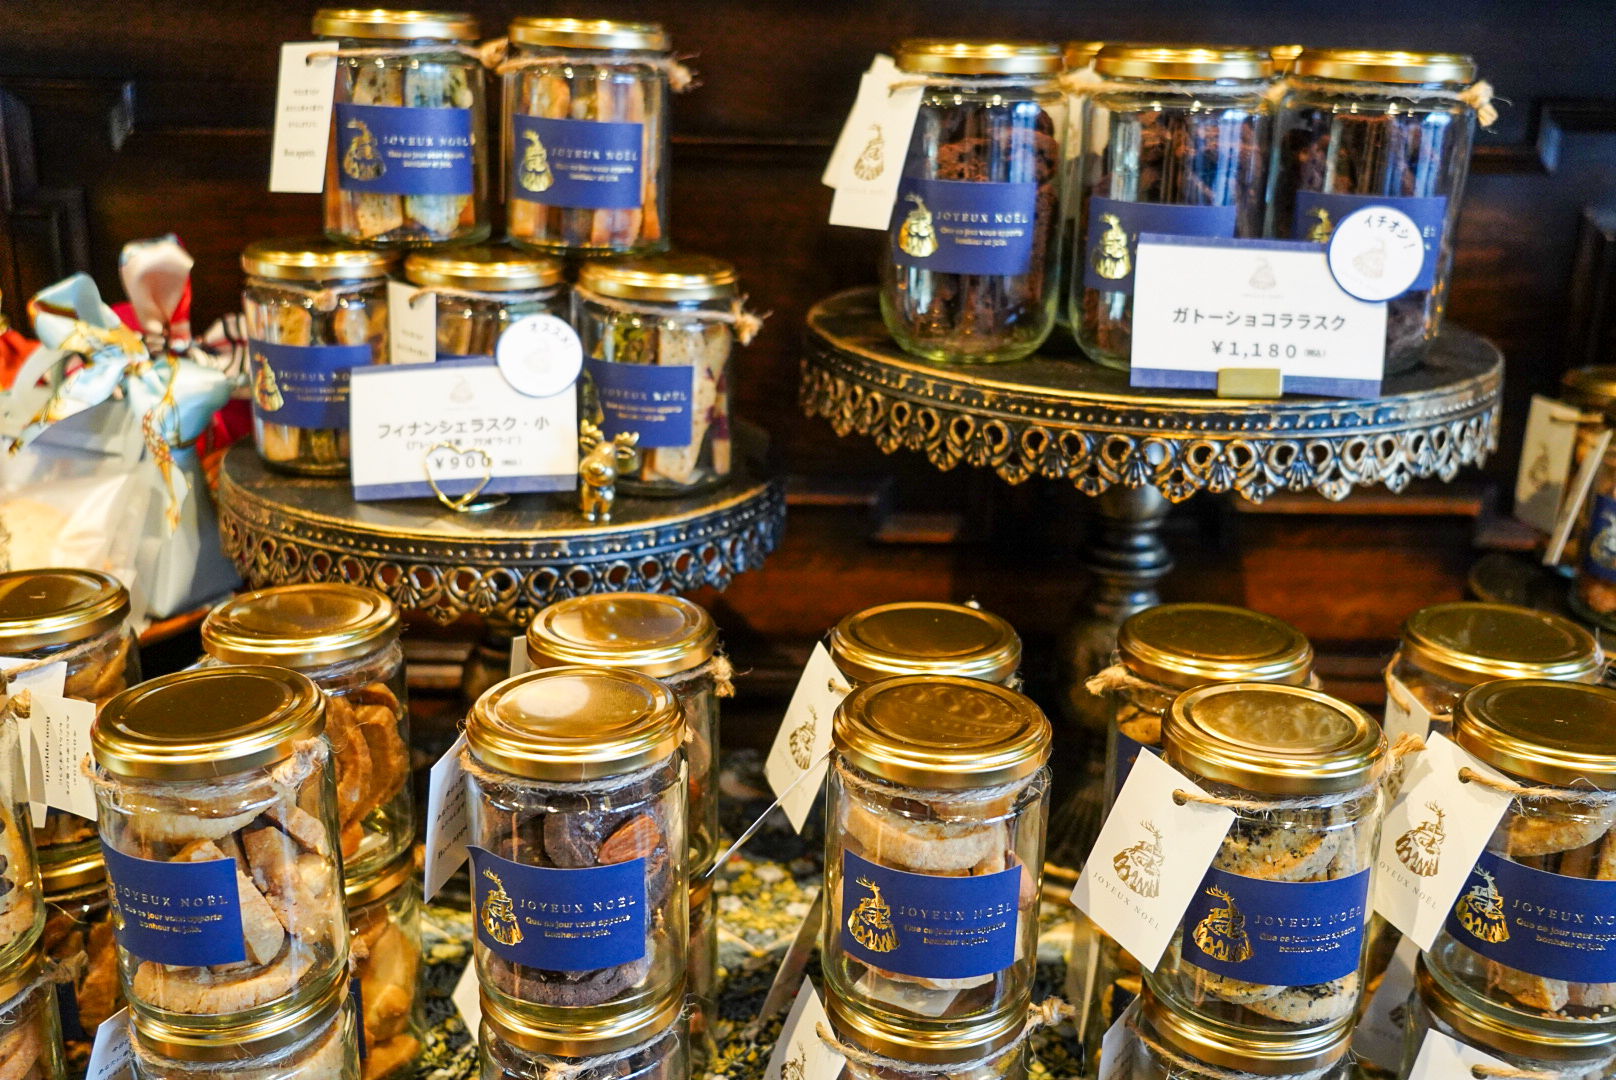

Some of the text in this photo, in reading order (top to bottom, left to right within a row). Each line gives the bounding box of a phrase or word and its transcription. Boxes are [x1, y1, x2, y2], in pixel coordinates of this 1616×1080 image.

[936, 211, 989, 223] JOYEUX
[1173, 307, 1346, 332] ガトーショコララスク
[1211, 340, 1298, 360] ¥1,180
[331, 370, 351, 381] NO
[1379, 861, 1437, 910] OYEUX NOËL
[119, 884, 228, 908] JOYEUX NOËL
[520, 895, 636, 913] JOYEUX NOËL
[1093, 872, 1160, 930] JOYEUX NOËL
[147, 911, 162, 921] jour
[899, 903, 1012, 921] JOYEUX NOËL
[1254, 914, 1322, 928] JOYEUX
[1512, 899, 1616, 926] JOYEUX NO
[555, 921, 573, 929] jour
